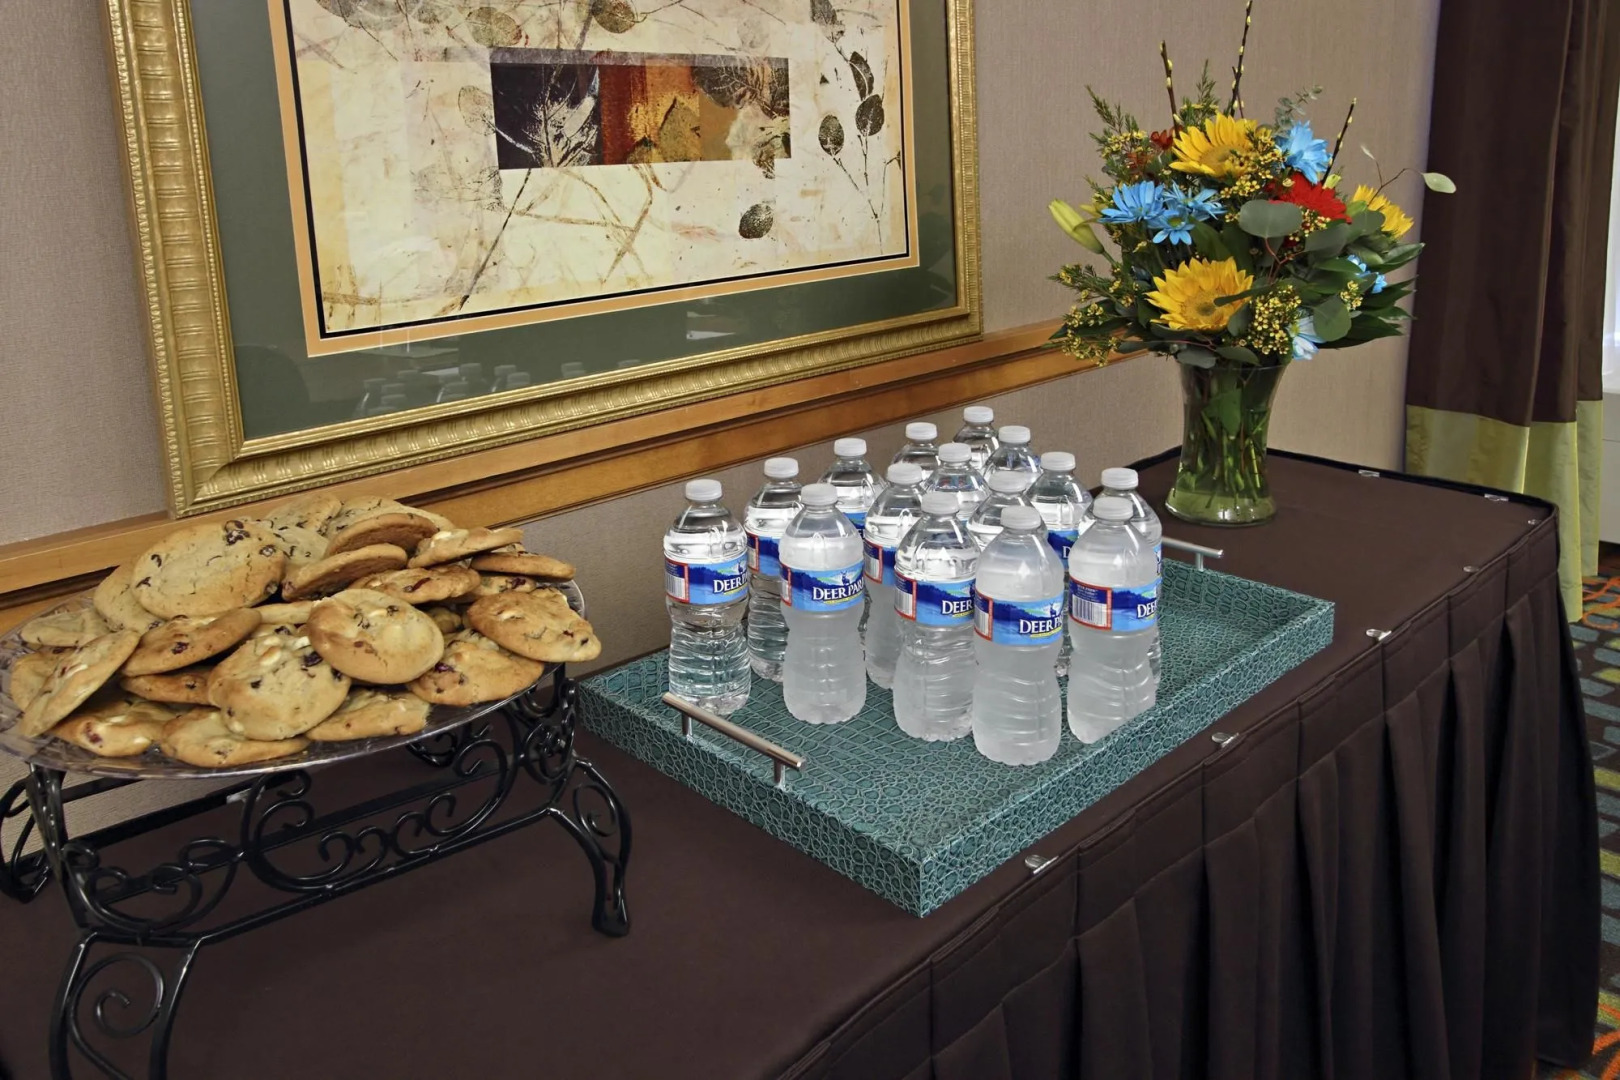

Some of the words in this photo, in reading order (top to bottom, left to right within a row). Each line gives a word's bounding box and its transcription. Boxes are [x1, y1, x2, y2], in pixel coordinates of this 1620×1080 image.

[713, 577, 742, 593] DEER
[812, 586, 847, 600] DEER
[941, 599, 973, 614] DEER
[1019, 618, 1053, 633] DEER
